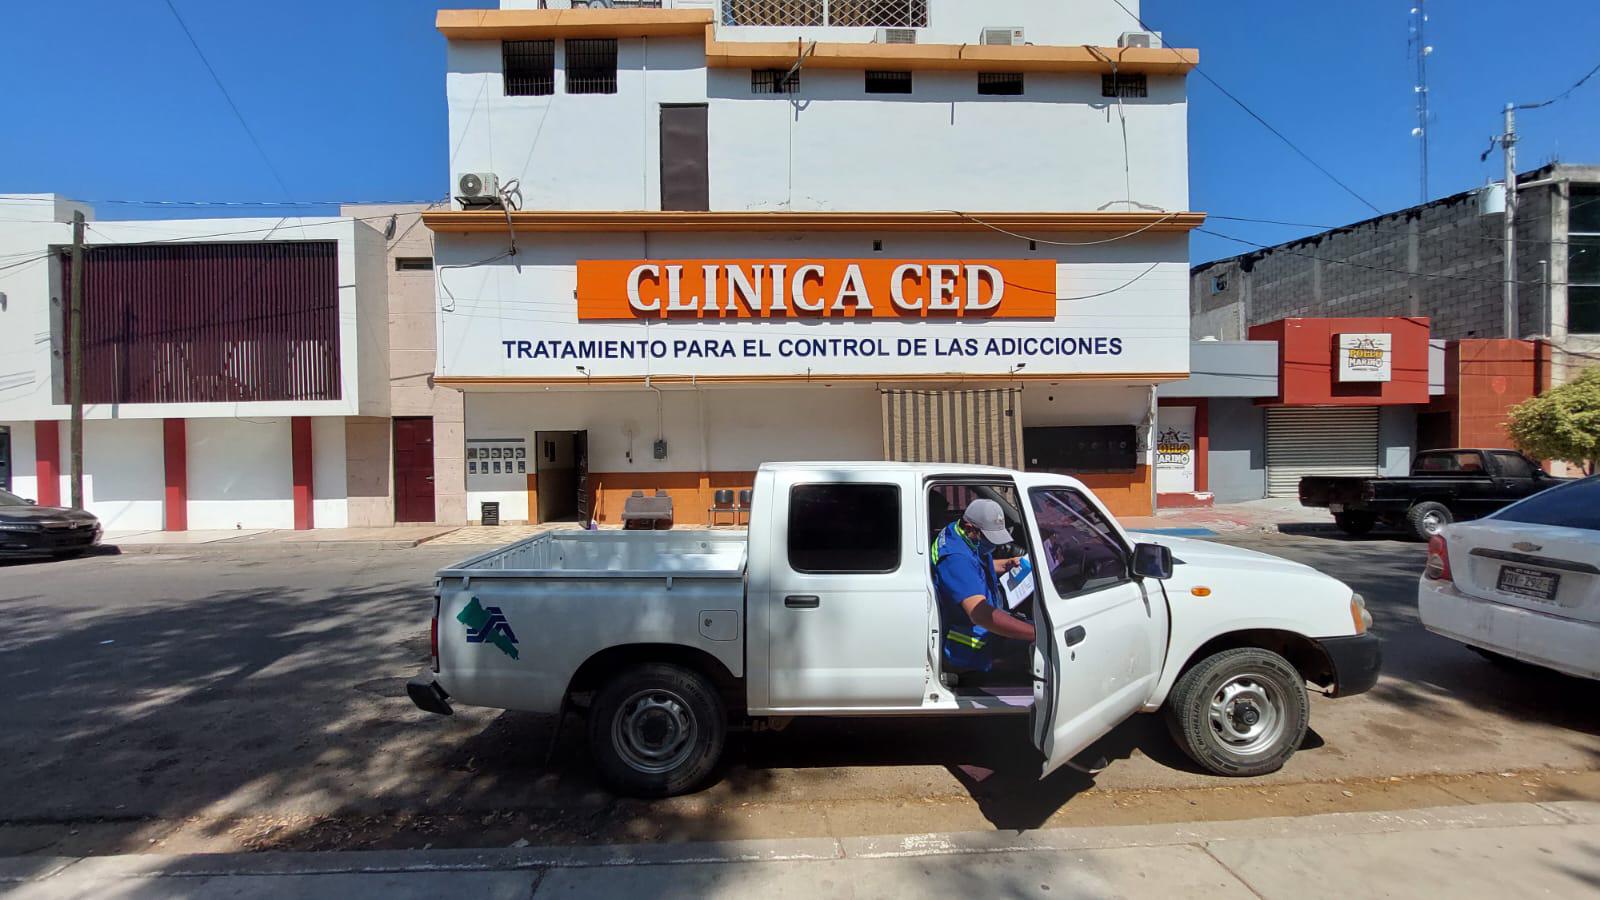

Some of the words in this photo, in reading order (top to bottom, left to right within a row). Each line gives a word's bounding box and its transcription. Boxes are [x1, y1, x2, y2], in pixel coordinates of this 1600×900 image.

[626, 264, 874, 311] CLINICA
[890, 264, 1005, 310] CED
[502, 340, 667, 359] TRATAMIENTO
[673, 339, 736, 358] PARA
[744, 339, 769, 357] EL
[778, 338, 889, 357] CONTROL
[897, 338, 927, 357] DE
[935, 338, 978, 357] LAS
[985, 336, 1122, 356] ADICCIONES
[1157, 443, 1190, 454] OLLO
